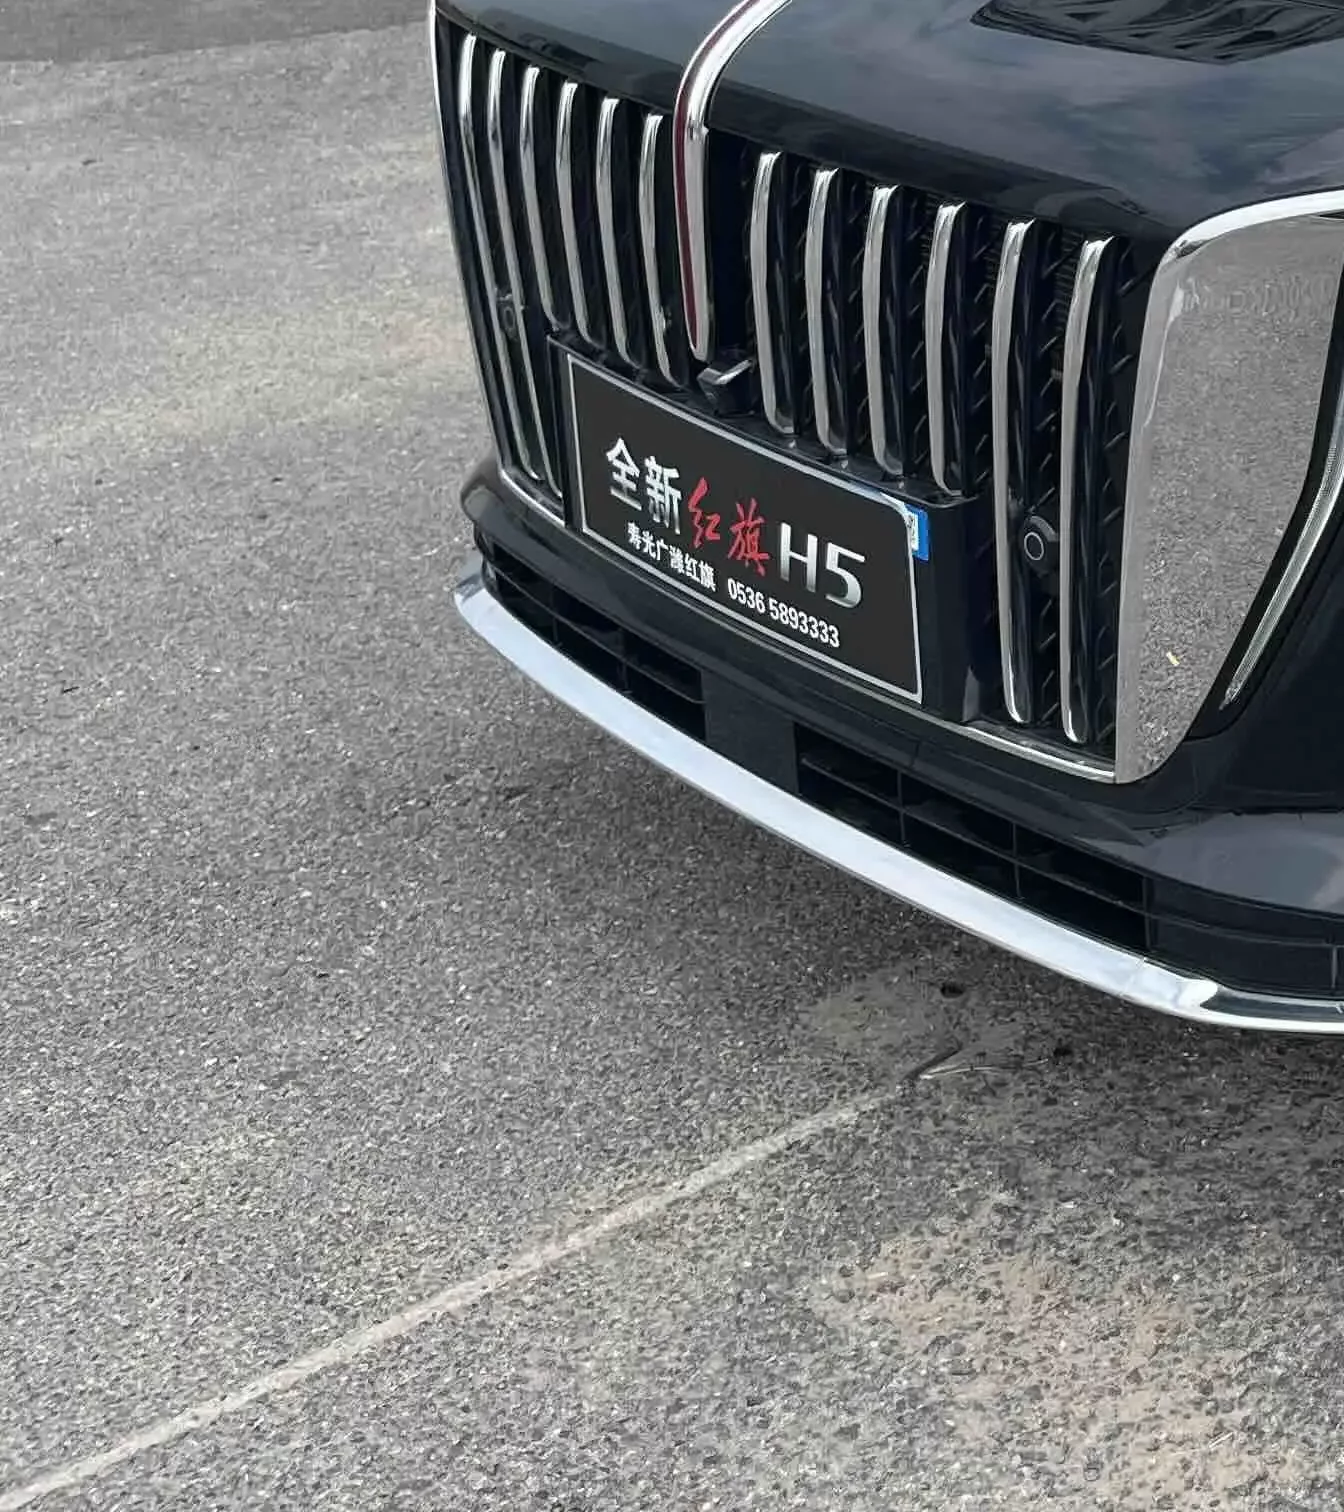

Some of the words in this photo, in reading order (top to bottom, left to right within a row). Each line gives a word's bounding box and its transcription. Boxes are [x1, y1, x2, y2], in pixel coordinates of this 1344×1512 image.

[627, 521, 717, 592] 寿光广潍红旗
[726, 577, 766, 615] 0536
[769, 599, 841, 648] 5893333
